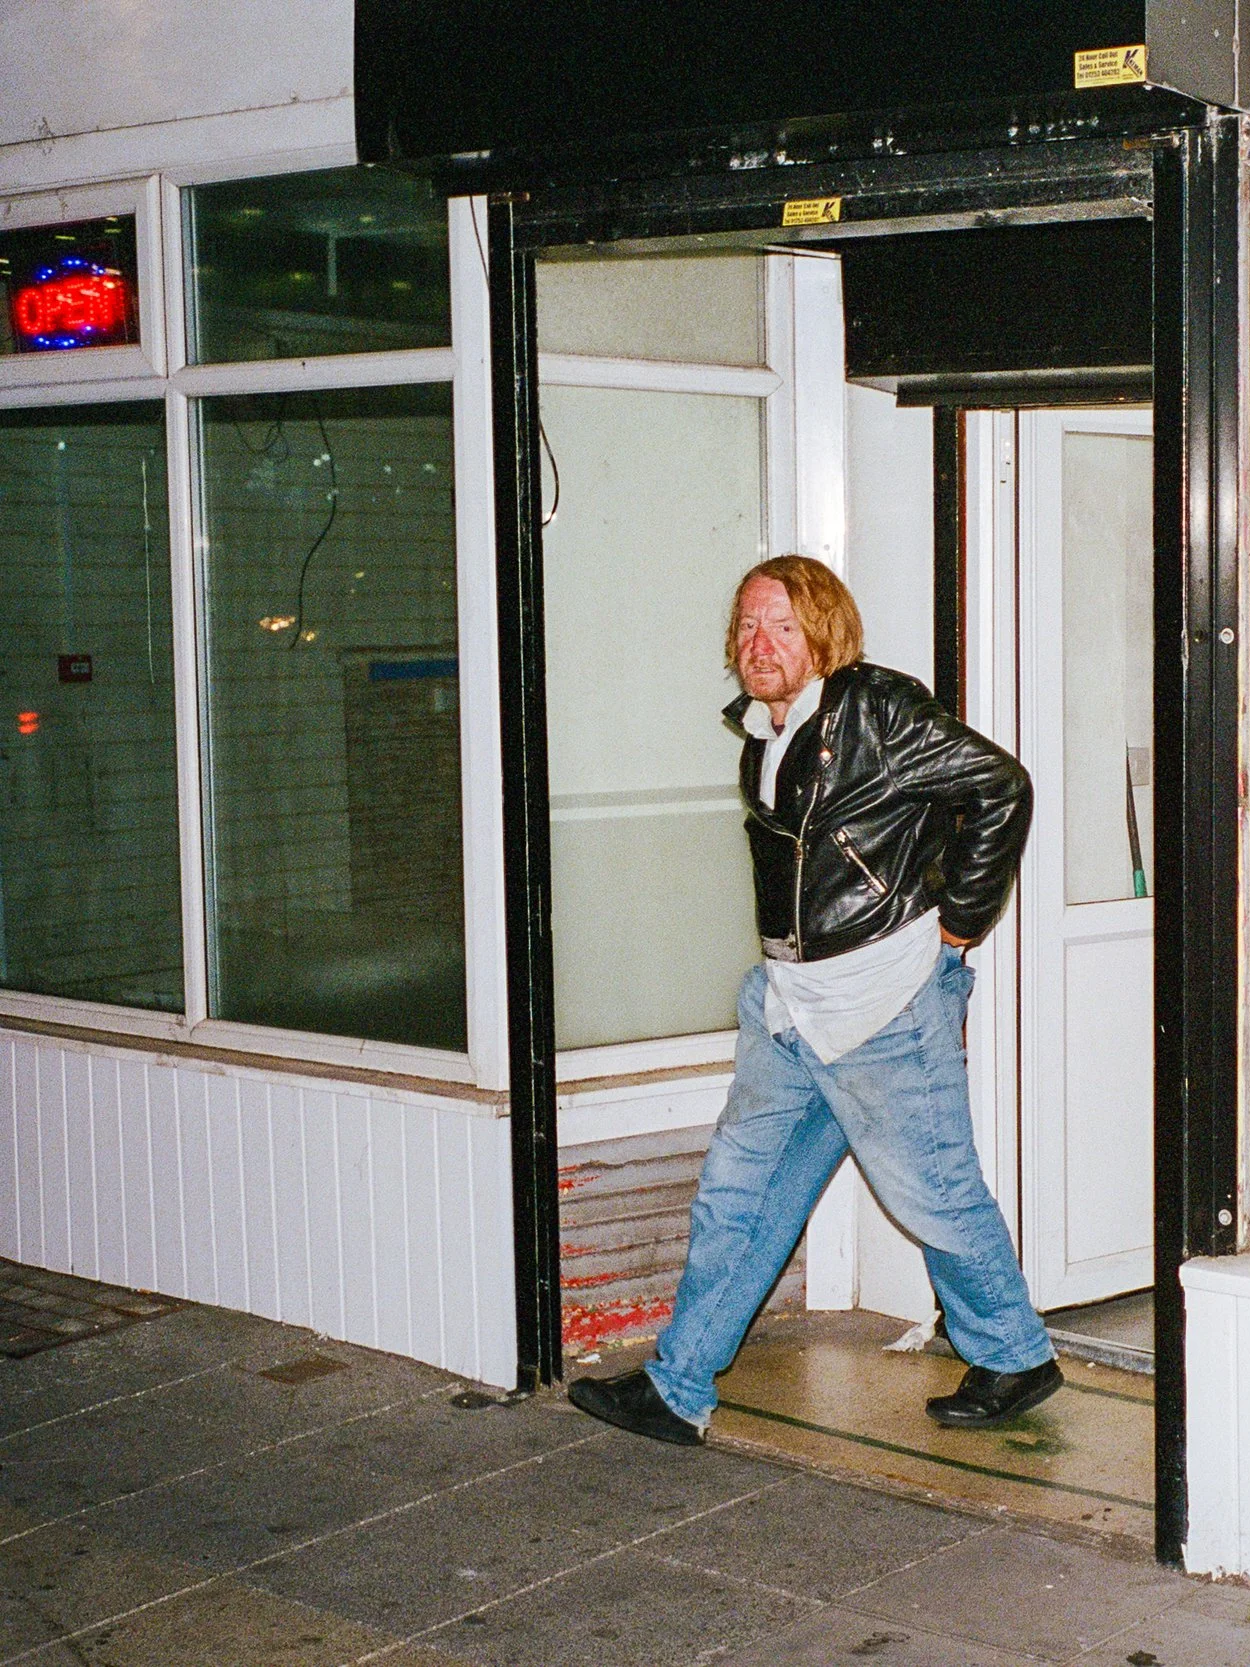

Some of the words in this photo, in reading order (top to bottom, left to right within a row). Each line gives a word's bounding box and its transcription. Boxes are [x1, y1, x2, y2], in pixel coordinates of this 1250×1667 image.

[1098, 51, 1108, 59] Call
[1109, 50, 1118, 58] Out
[1079, 62, 1093, 71] Sales
[1098, 60, 1118, 68] Service
[17, 276, 126, 334] OPEN
